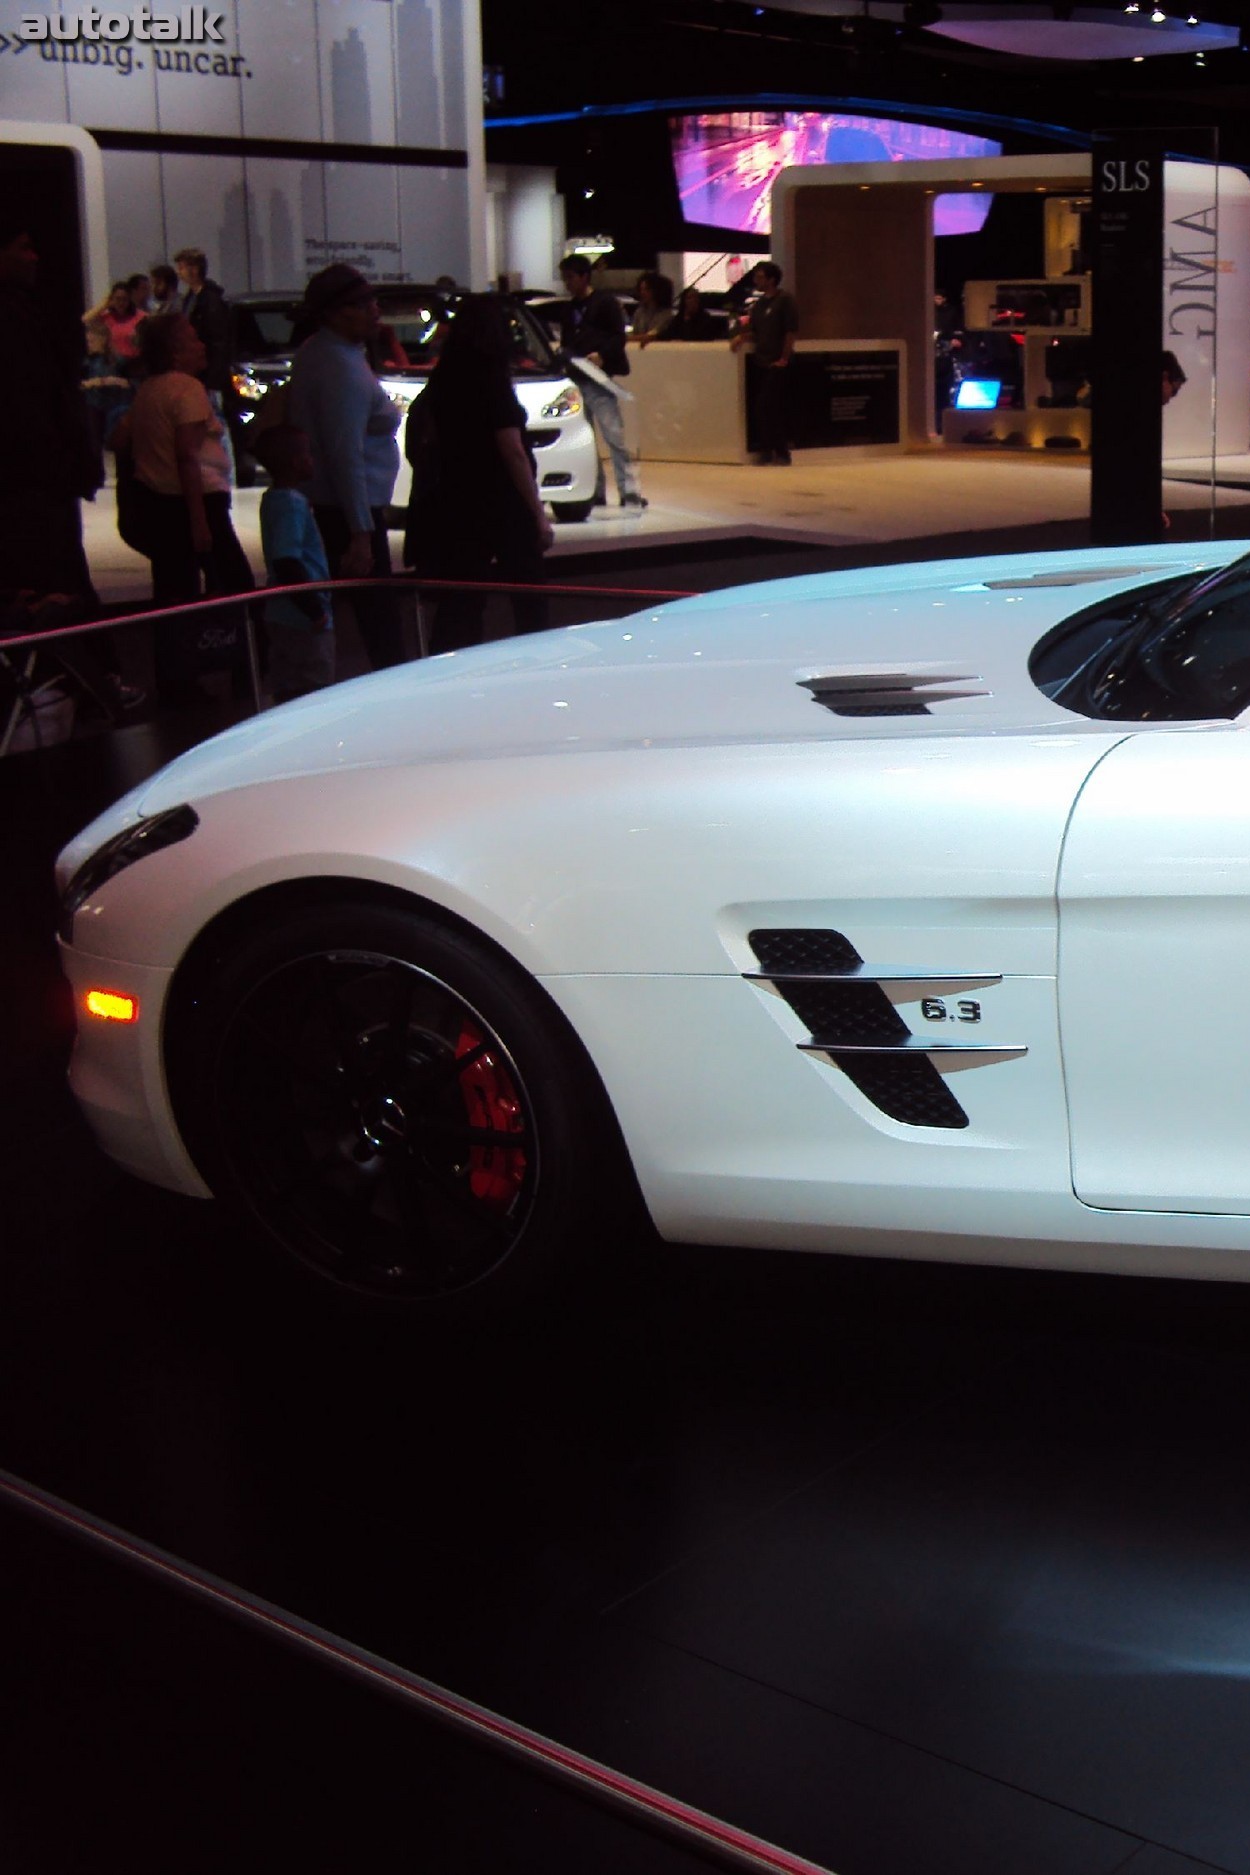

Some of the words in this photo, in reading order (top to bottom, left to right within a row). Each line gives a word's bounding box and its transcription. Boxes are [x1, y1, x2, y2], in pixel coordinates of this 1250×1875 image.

[154, 47, 253, 78] uncar.
[1102, 160, 1150, 192] SLS
[921, 998, 982, 1023] 6.3
